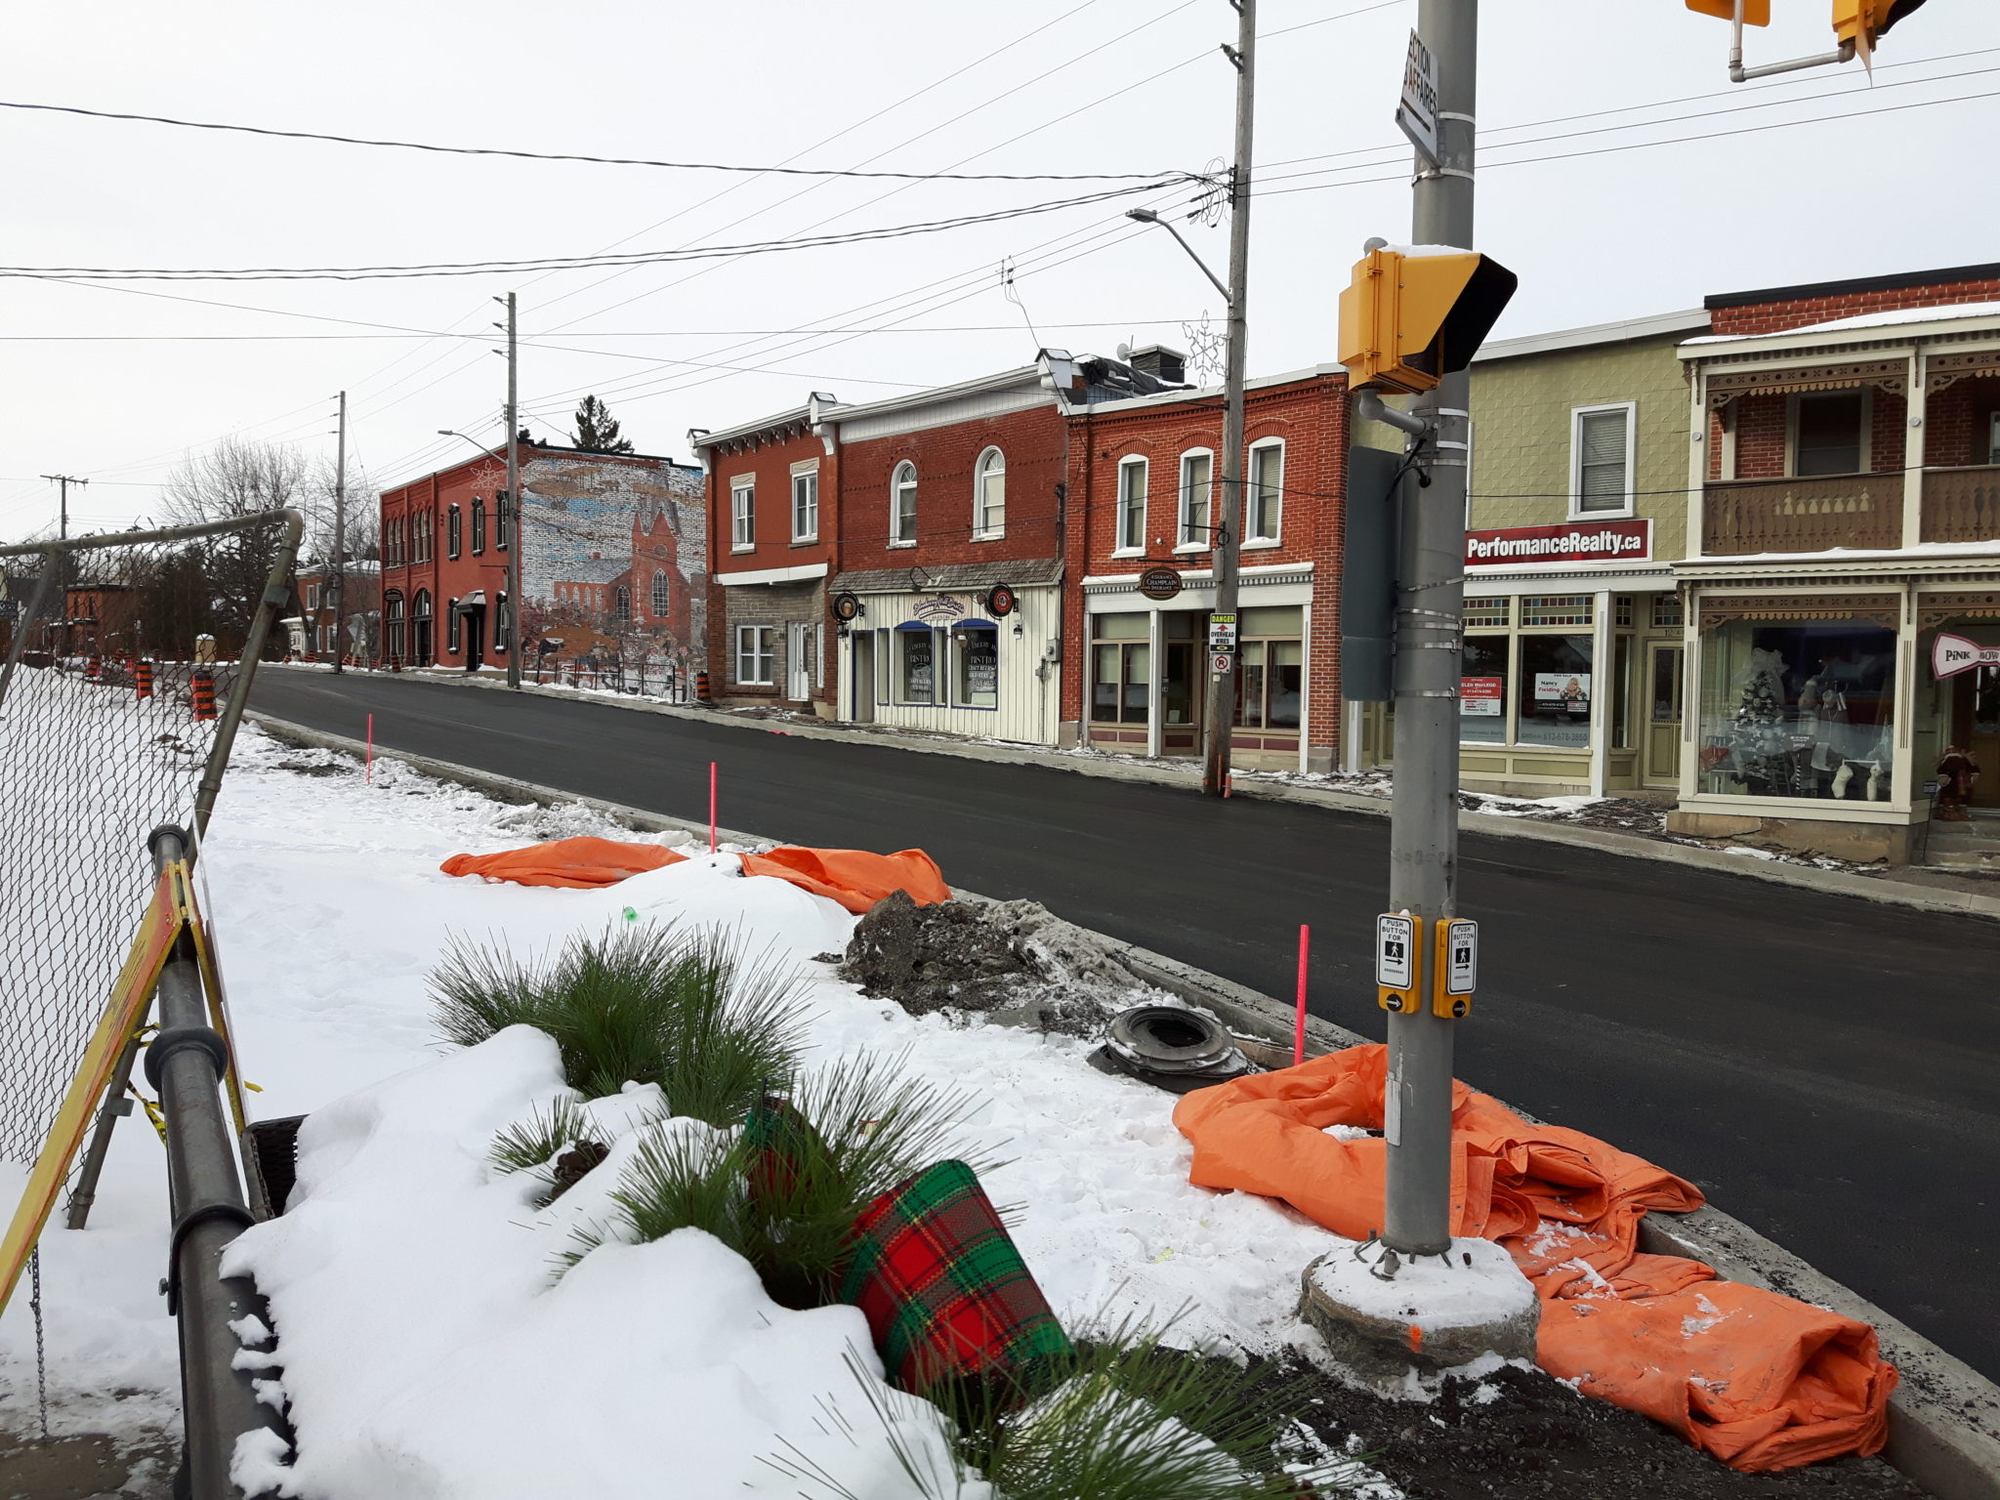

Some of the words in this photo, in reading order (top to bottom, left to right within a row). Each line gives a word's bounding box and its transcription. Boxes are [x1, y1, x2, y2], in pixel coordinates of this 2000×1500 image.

[1467, 530, 1641, 559] PerformanceRealty.ca
[1211, 615, 1235, 623] DANGER
[1979, 651, 1999, 660] BOW
[1386, 920, 1404, 928] PUSH
[1382, 926, 1408, 936] BUTTON
